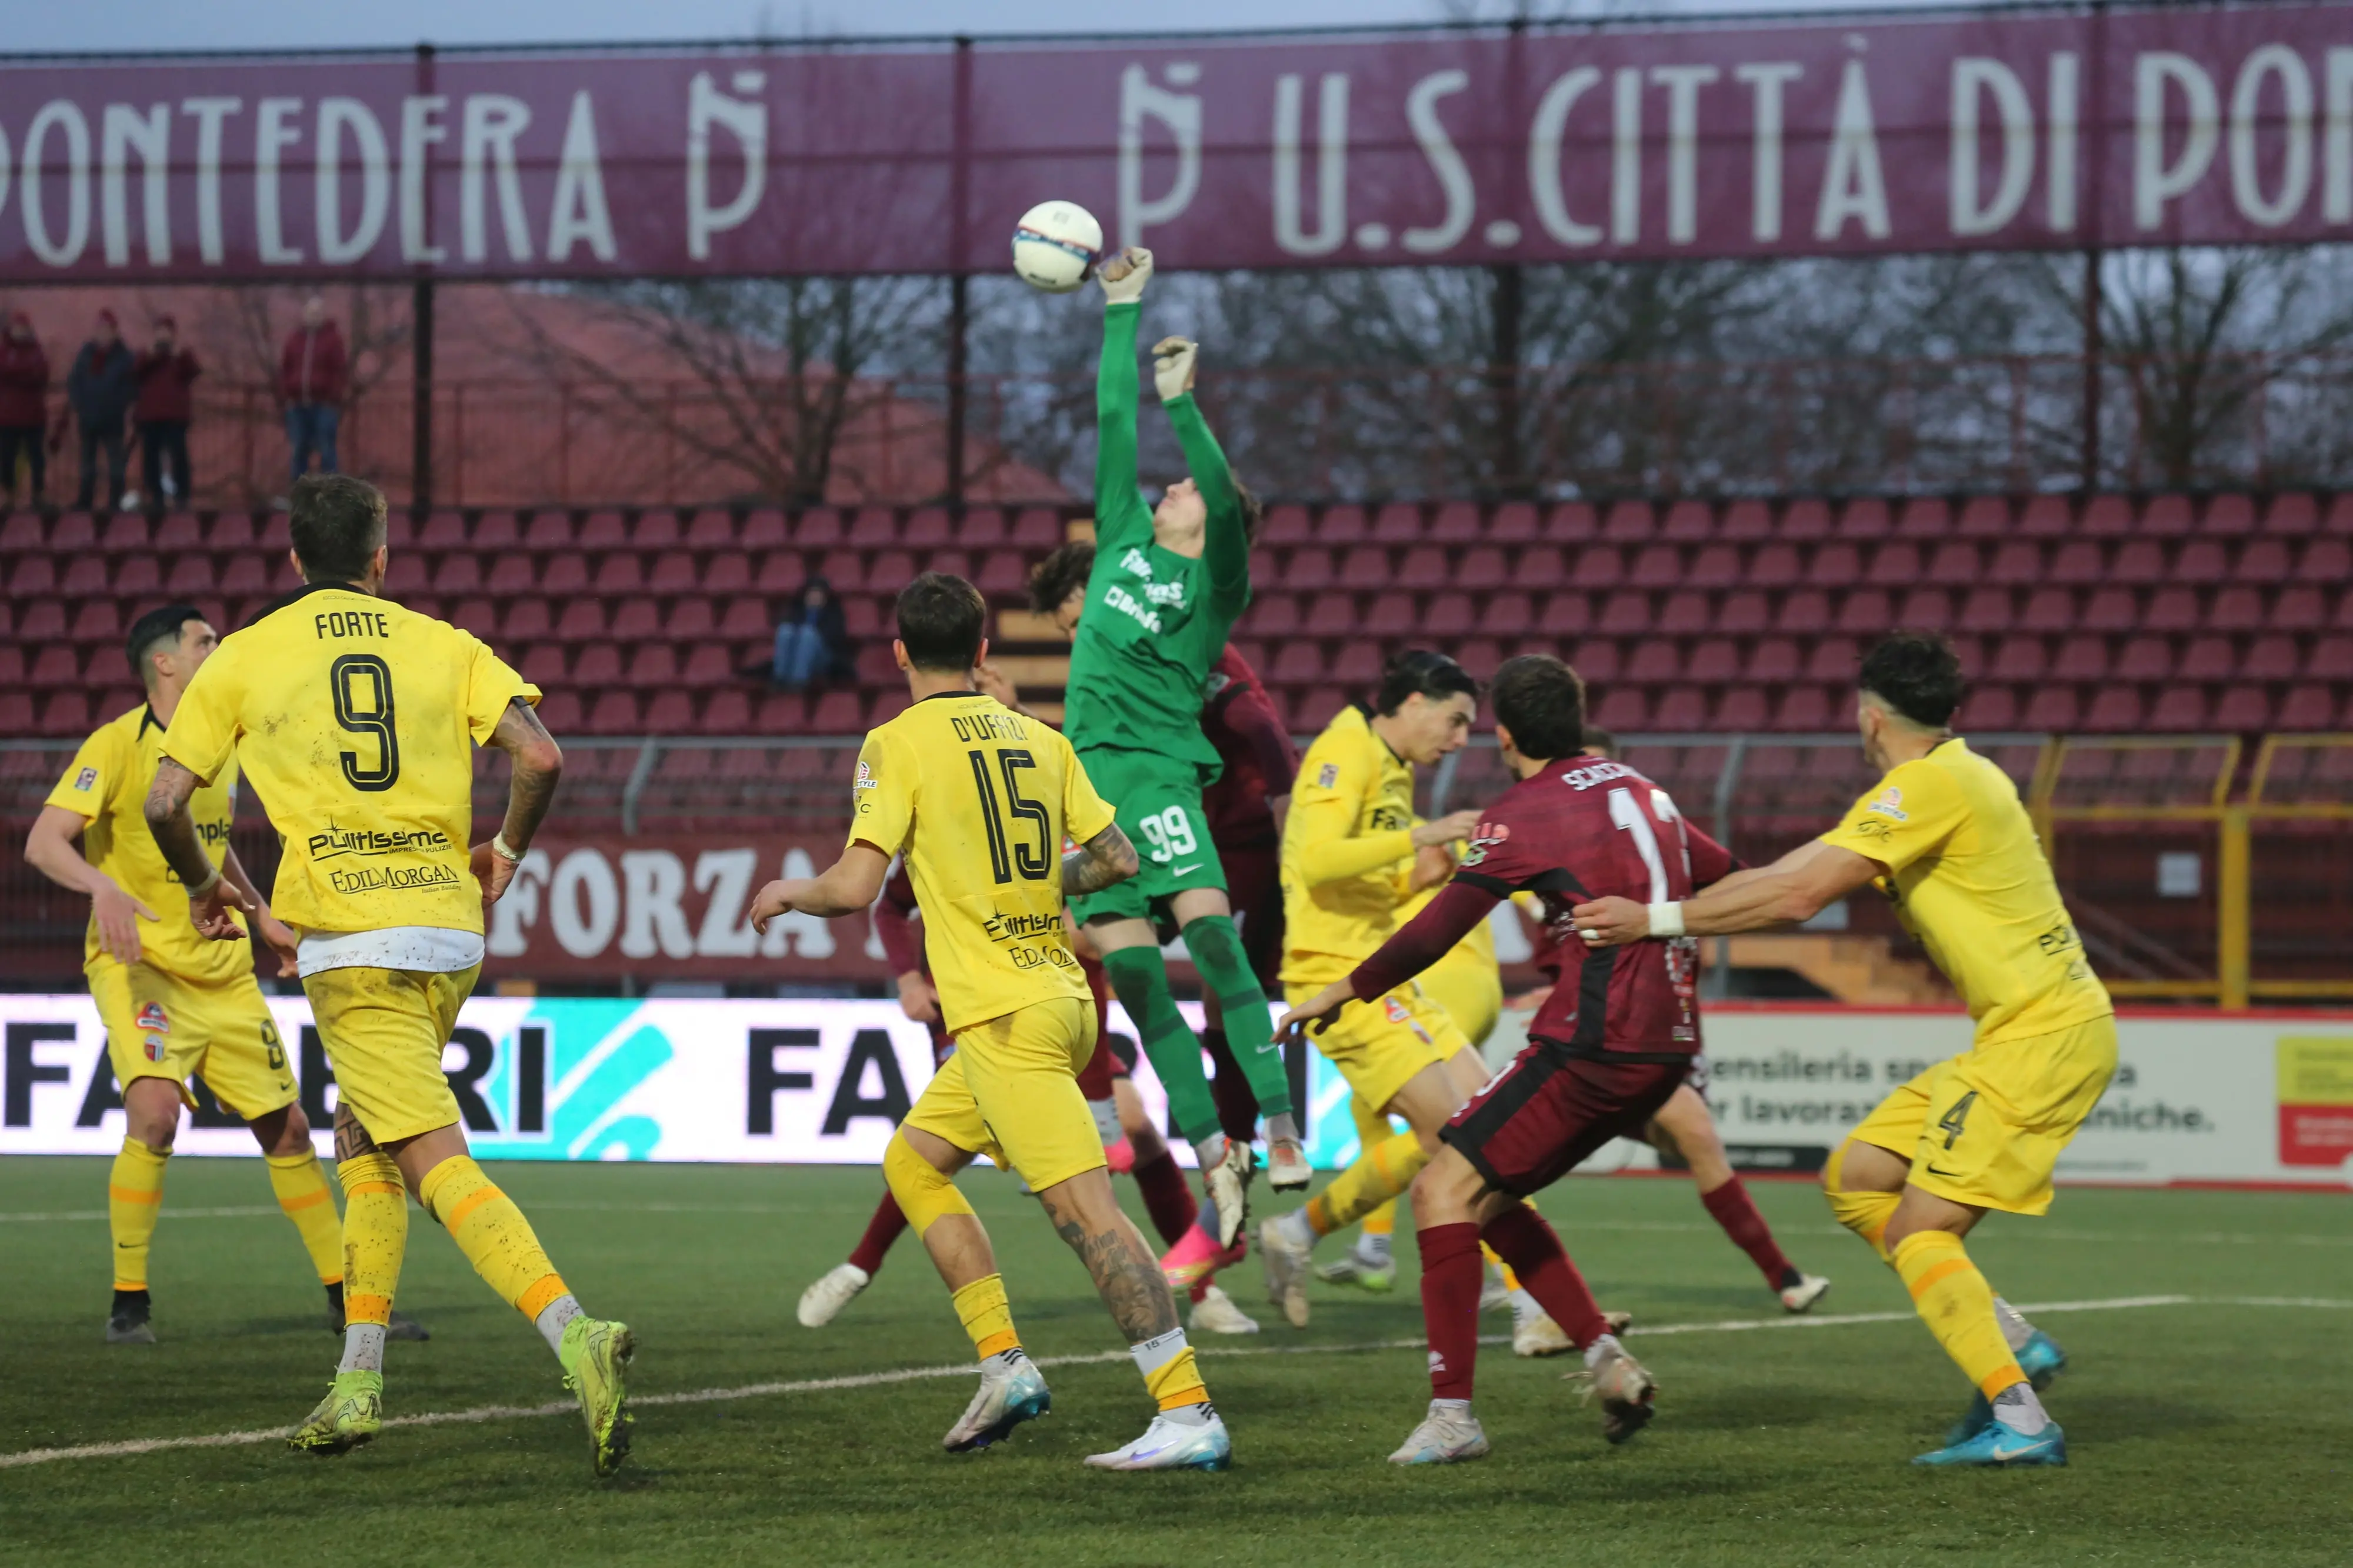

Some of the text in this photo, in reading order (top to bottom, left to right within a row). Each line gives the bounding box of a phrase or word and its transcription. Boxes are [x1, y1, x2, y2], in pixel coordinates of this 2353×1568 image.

[0, 91, 618, 267] ONTEDERA
[1949, 51, 2080, 234] DI
[314, 611, 389, 639] FORTE
[331, 654, 399, 792] 9
[425, 843, 452, 853] PULIZIE
[968, 748, 1052, 885] 15
[1139, 805, 1197, 863] 99
[487, 847, 836, 961] FORZA
[260, 1019, 284, 1070] 8
[1938, 1089, 1979, 1150] 4
